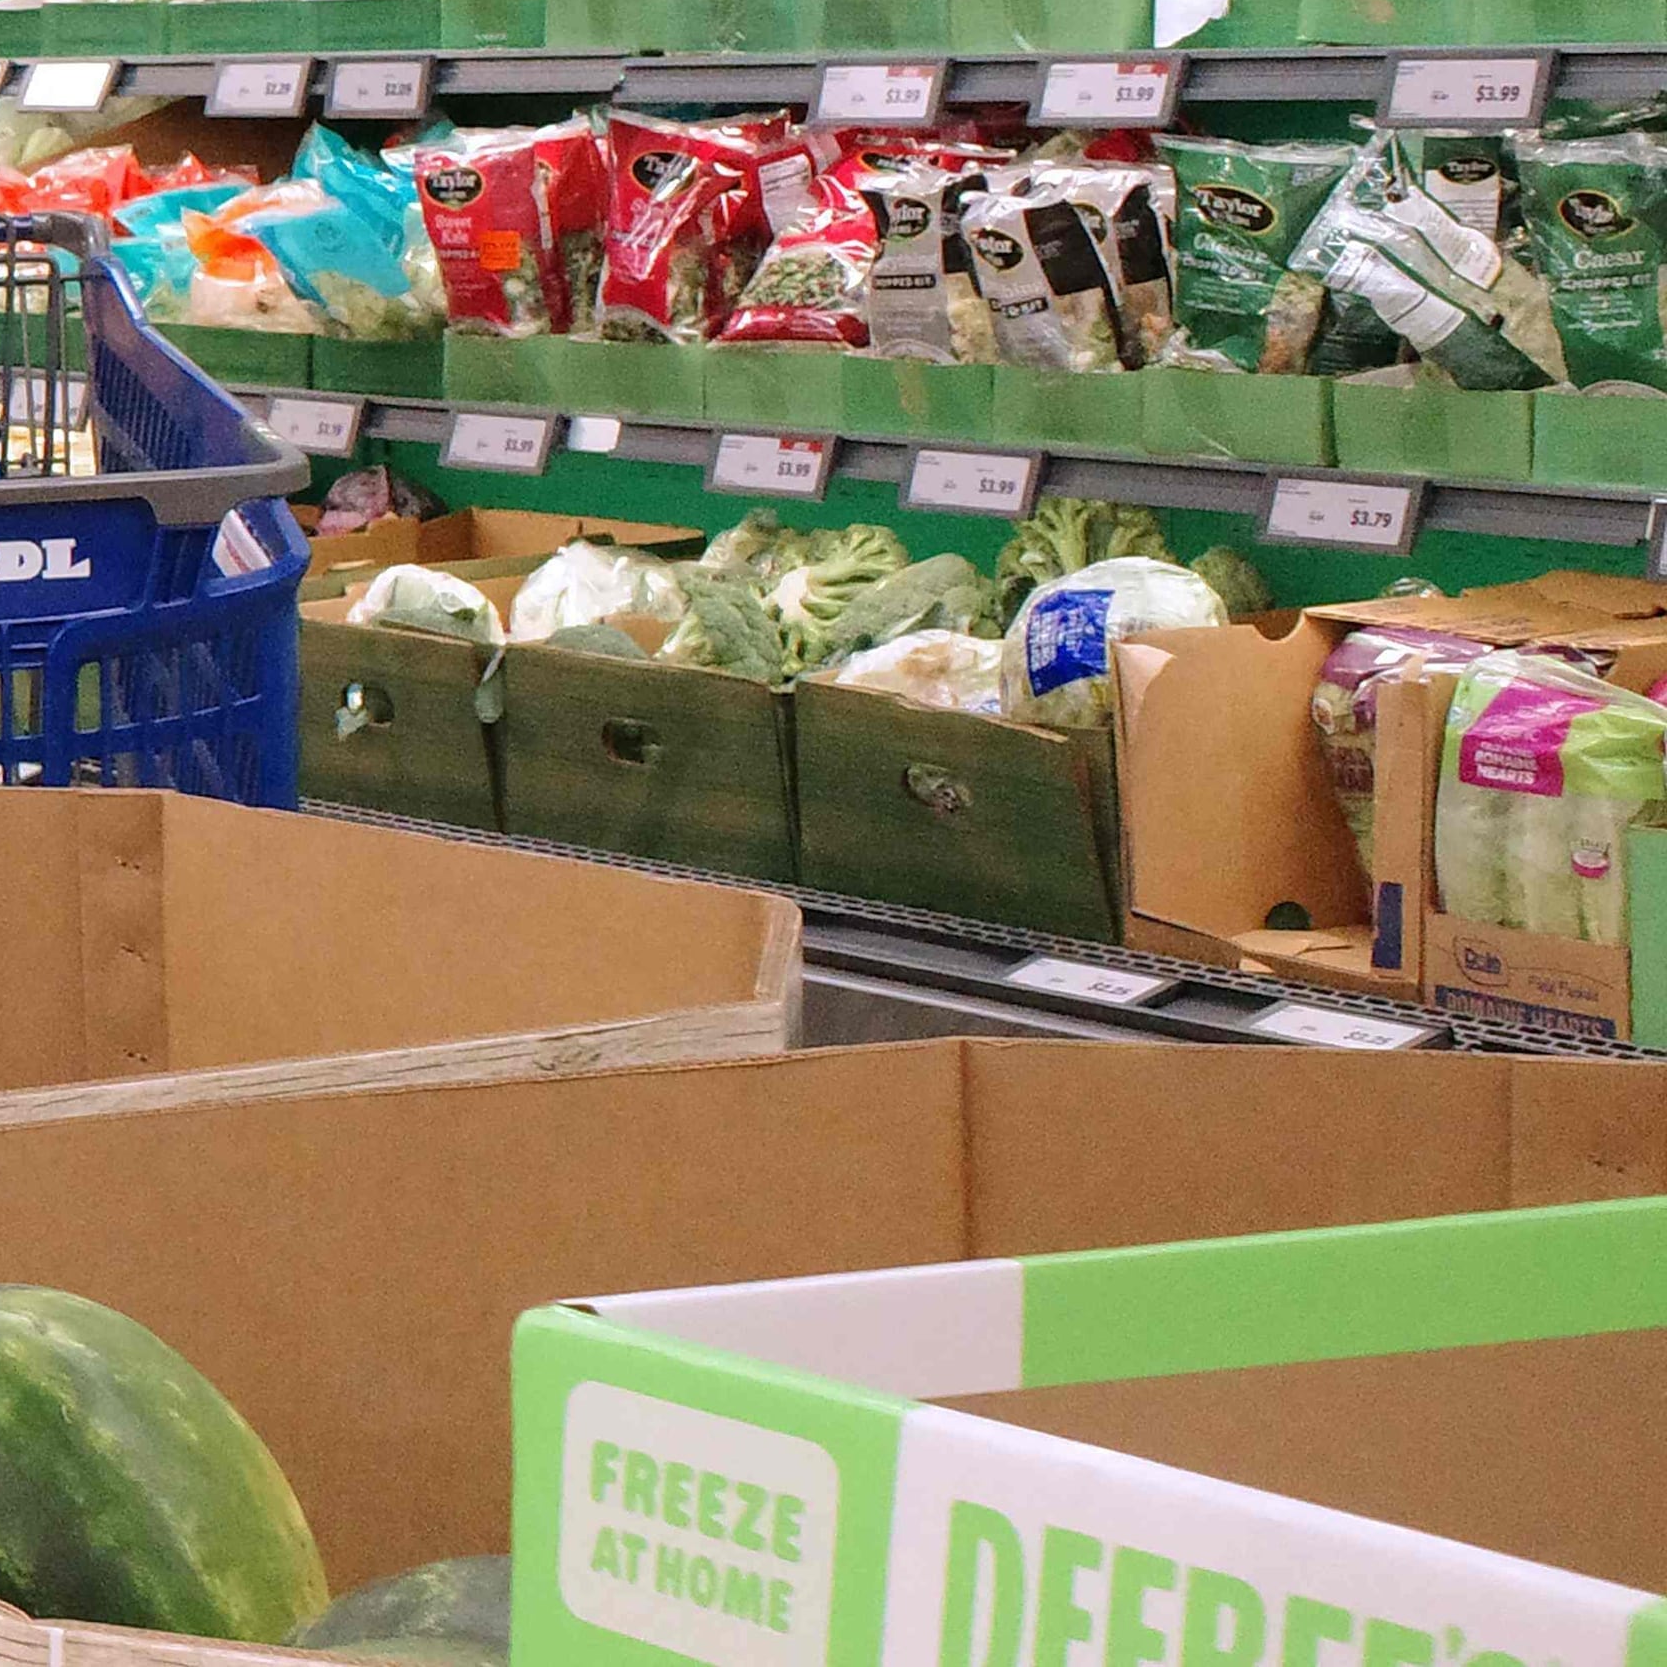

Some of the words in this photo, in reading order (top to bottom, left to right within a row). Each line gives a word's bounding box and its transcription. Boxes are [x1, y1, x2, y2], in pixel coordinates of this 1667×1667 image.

[1474, 84, 1521, 104] $3.99
[1573, 249, 1646, 269] Caesar
[1350, 509, 1393, 529] $3.79
[590, 1439, 806, 1563] FREEZE
[590, 1524, 648, 1585] AT
[655, 1541, 795, 1635] HOME
